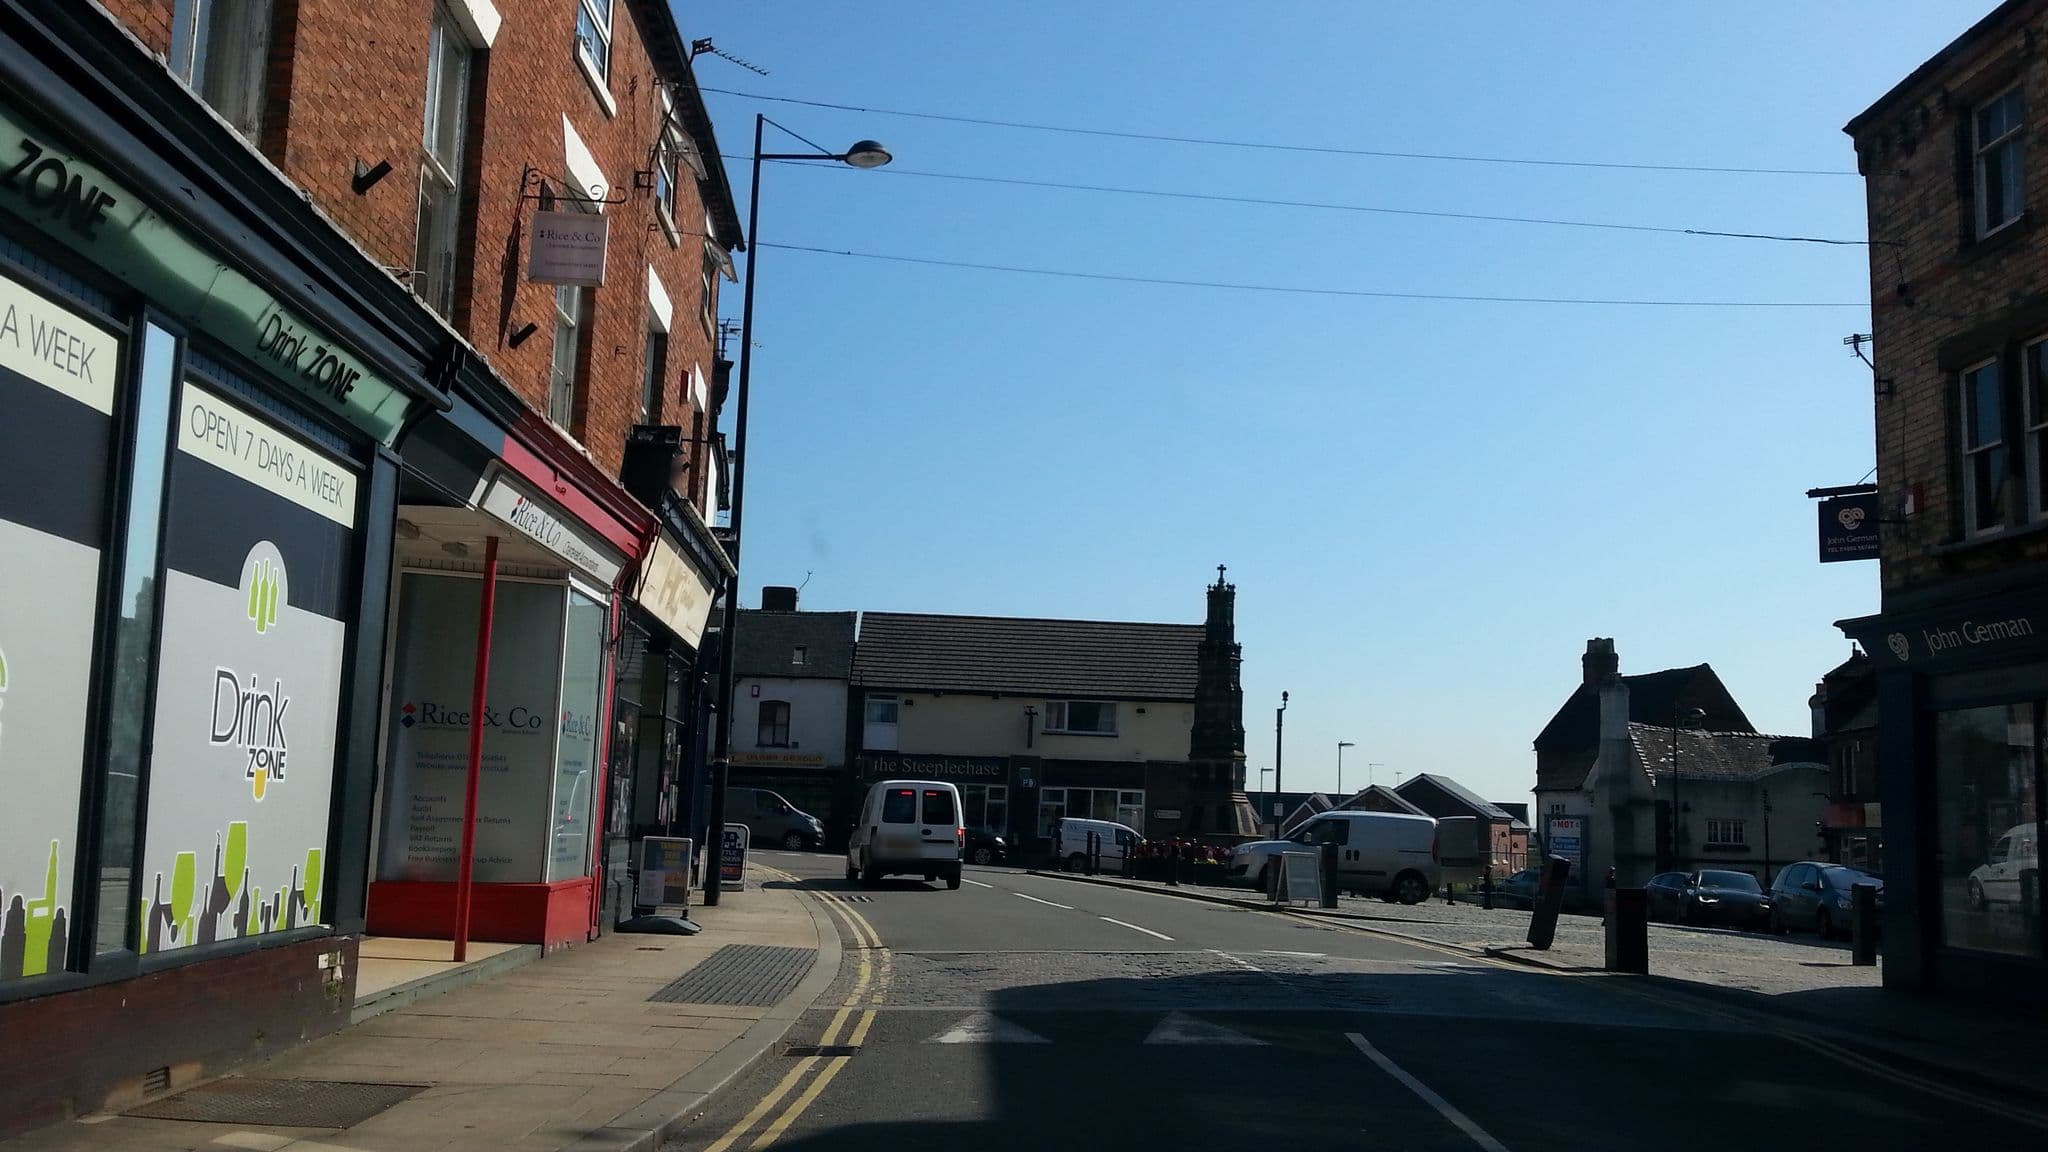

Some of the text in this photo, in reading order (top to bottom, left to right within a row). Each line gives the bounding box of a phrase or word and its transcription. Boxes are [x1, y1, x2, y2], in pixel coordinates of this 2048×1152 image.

[0, 138, 117, 242] ZONE
[547, 229, 569, 240] Rice
[585, 232, 601, 242] Co
[0, 304, 96, 385] A WEEK
[257, 313, 361, 404] Drink ZONE
[191, 404, 345, 508] OPEN 7 DAYS A WEEK
[514, 499, 538, 532] Rice
[546, 520, 561, 547] Co
[1923, 617, 2033, 657] John German
[211, 669, 289, 749] Drink
[418, 703, 542, 729] Rice & Co
[246, 748, 286, 780] ZONE
[874, 757, 1000, 777] the Steeplechase
